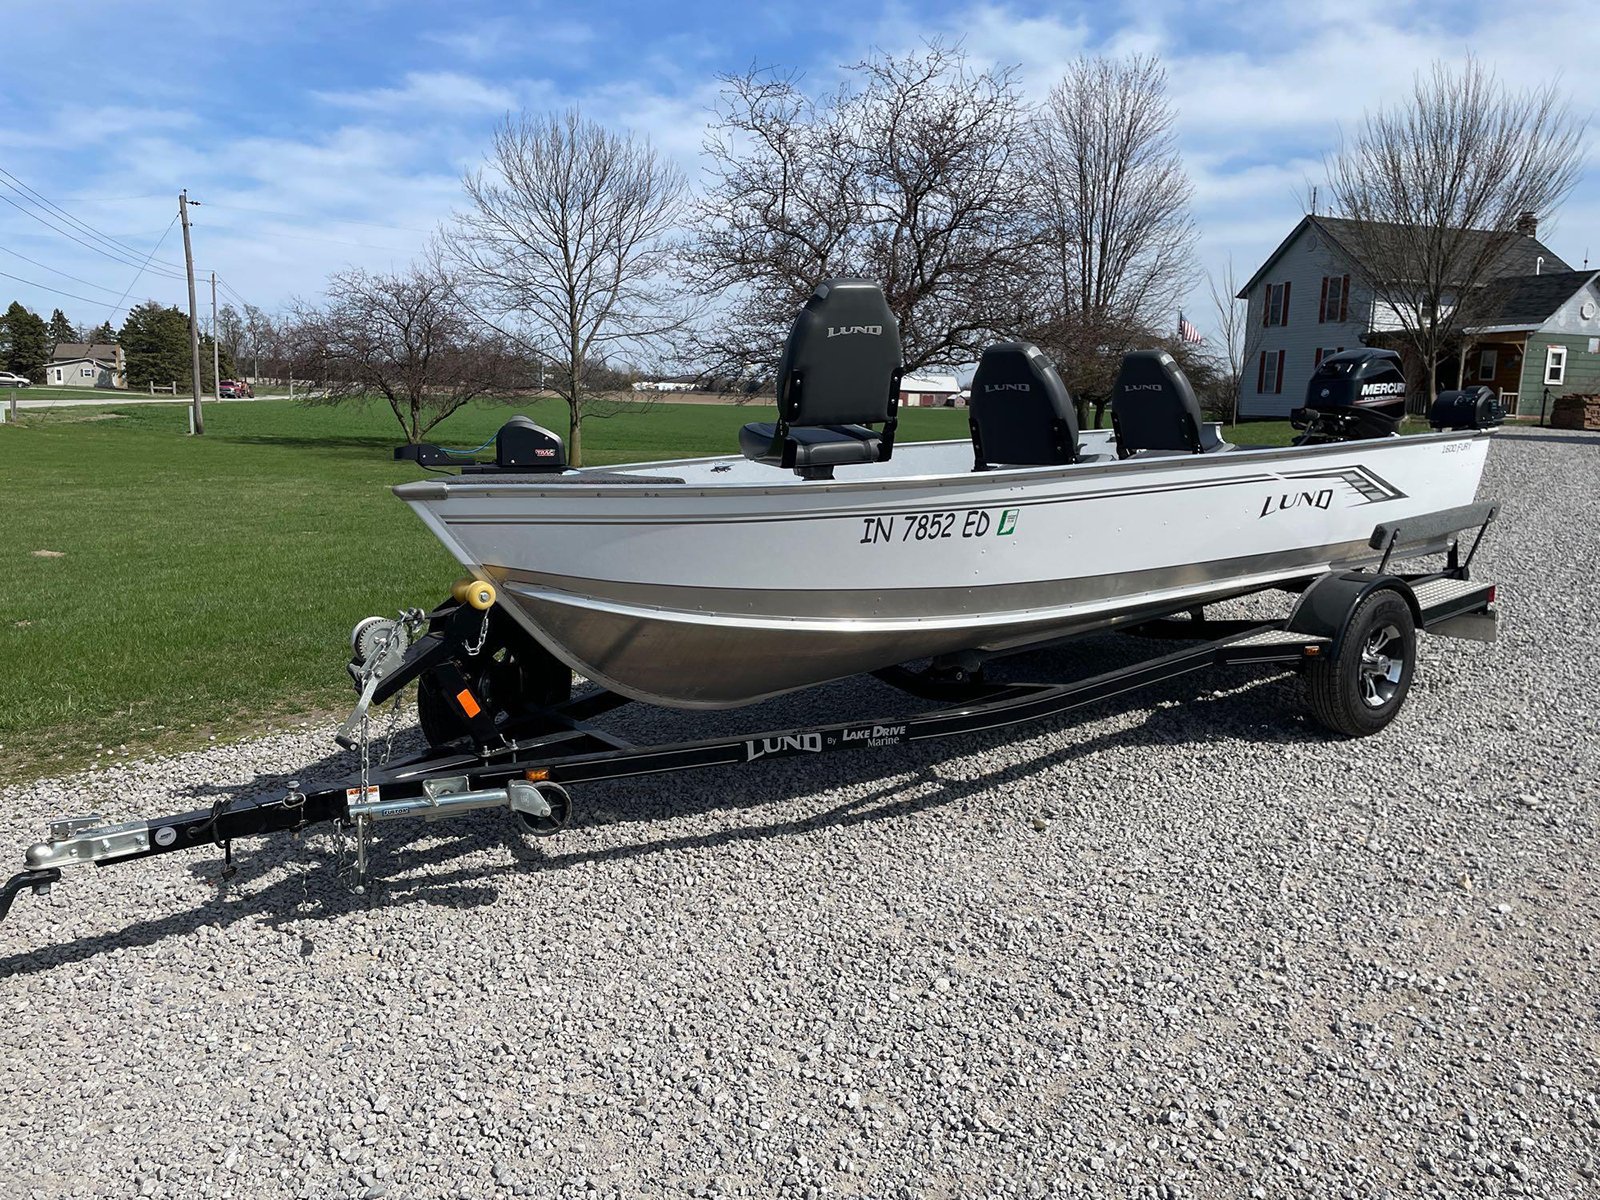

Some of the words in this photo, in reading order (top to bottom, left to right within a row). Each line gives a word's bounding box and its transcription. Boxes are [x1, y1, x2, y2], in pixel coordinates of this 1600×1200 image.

[827, 325, 882, 338] LUND
[984, 383, 1030, 393] LUND
[1124, 384, 1162, 392] LUND
[1258, 489, 1334, 519] LUND
[860, 517, 894, 544] IN
[902, 512, 956, 542] 7852
[962, 510, 990, 538] ED
[842, 729, 871, 741] LAKE
[872, 725, 906, 738] DRIVE
[745, 732, 823, 762] LUND
[827, 737, 837, 746] By
[867, 736, 900, 748] Marine
